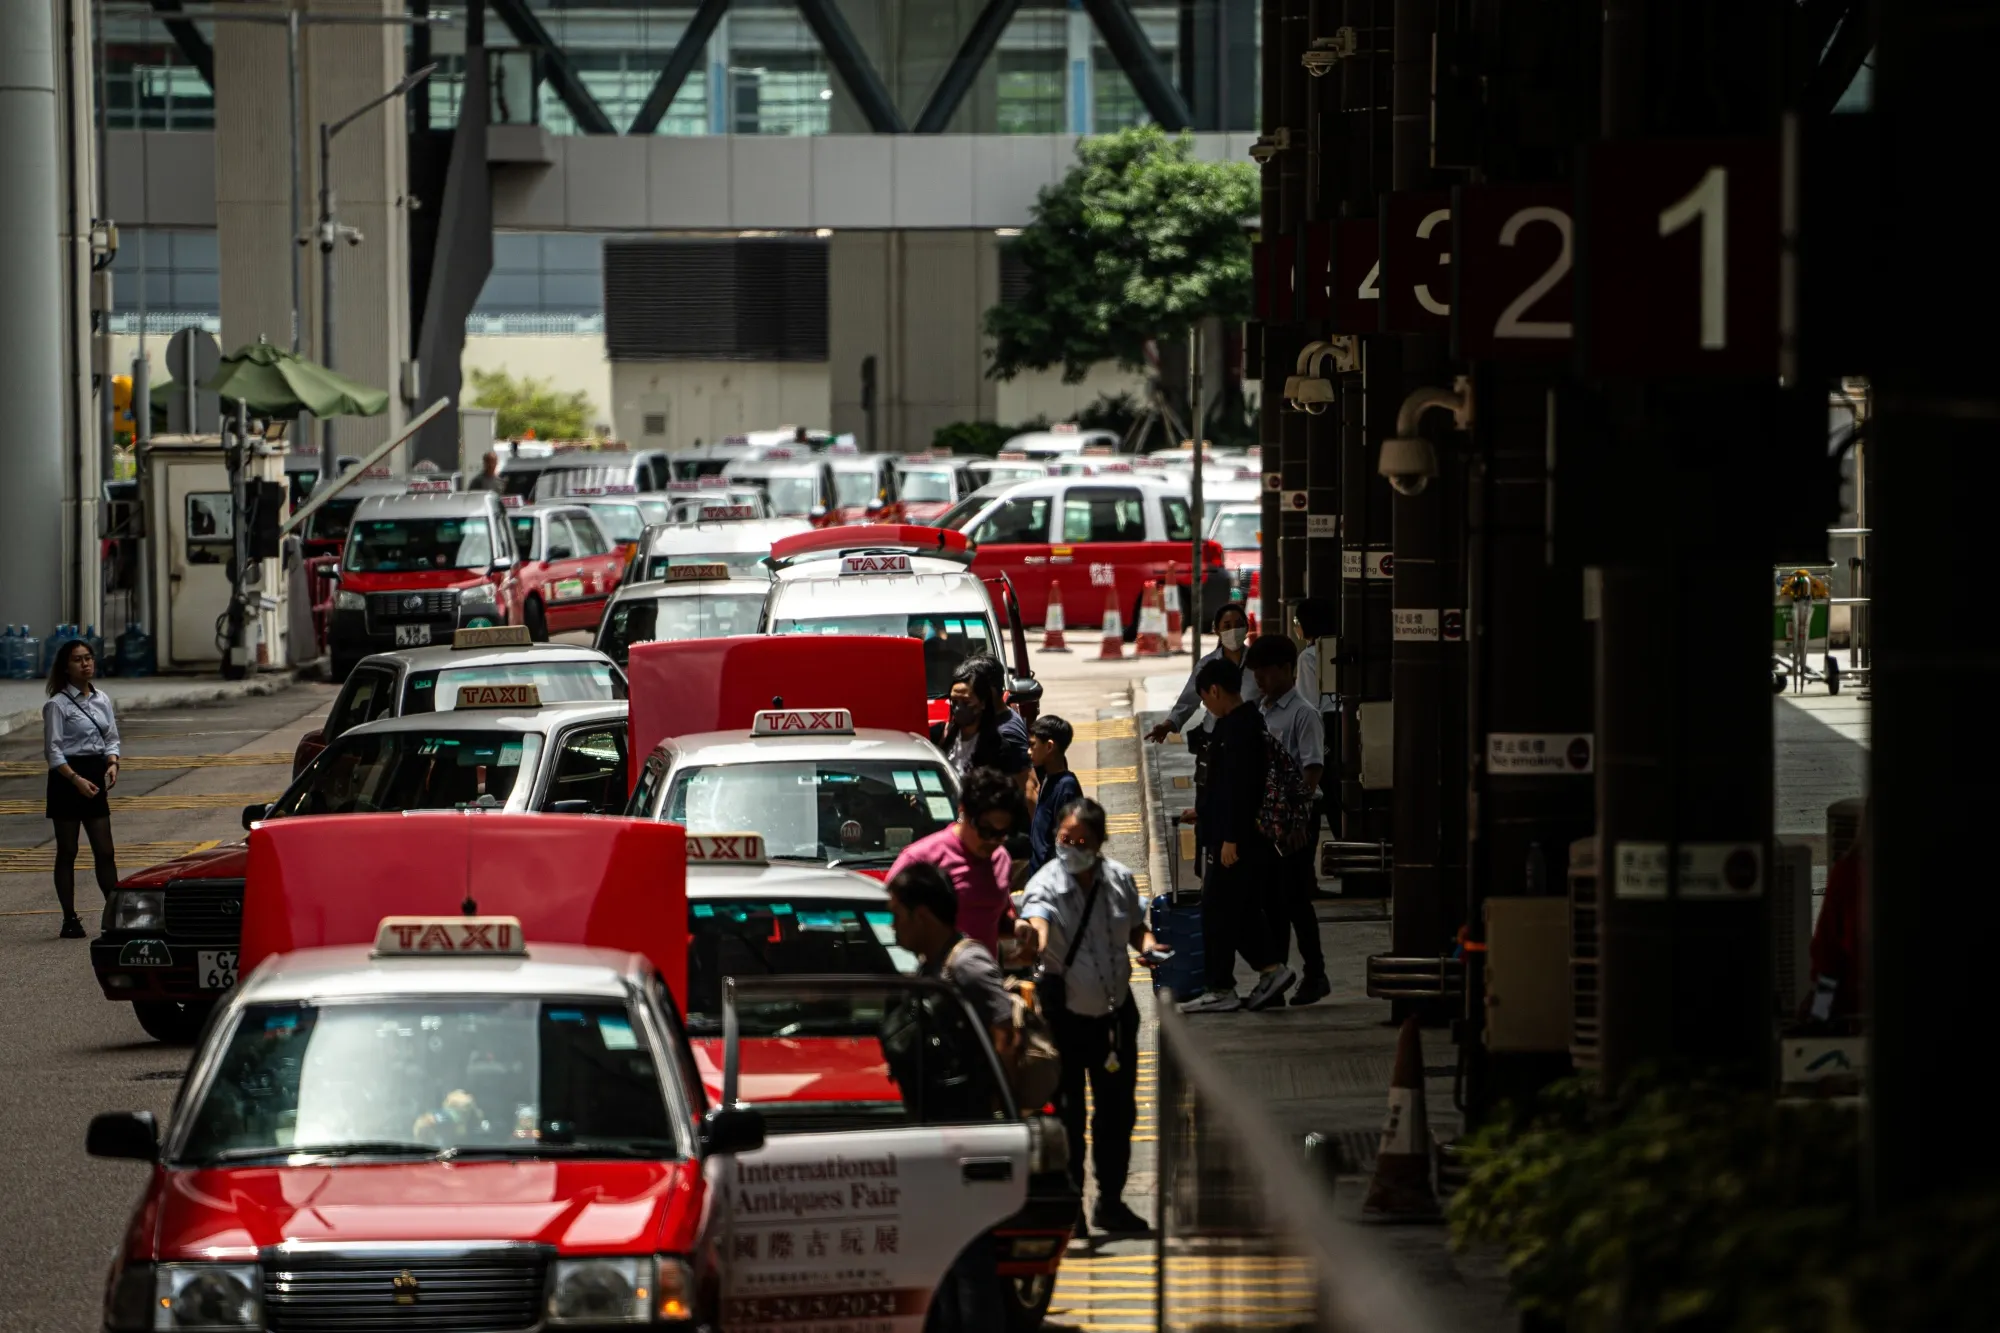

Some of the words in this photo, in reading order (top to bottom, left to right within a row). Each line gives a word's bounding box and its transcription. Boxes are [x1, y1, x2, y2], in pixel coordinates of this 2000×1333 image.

[1657, 164, 1728, 351] 1
[1492, 205, 1575, 339] 2
[703, 506, 751, 518] TAXI
[671, 565, 724, 578] TAXI
[847, 556, 906, 571] TAXI
[460, 628, 525, 645] TAXI
[1402, 625, 1438, 636] smoking
[462, 686, 528, 705] TAXI
[763, 711, 844, 731] TAXI
[1511, 755, 1565, 769] smoking
[686, 835, 758, 860] AXI
[389, 923, 512, 951] TAXI
[139, 944, 150, 957] 4
[129, 957, 161, 965] SEATS
[216, 951, 240, 970] GZ
[207, 970, 235, 988] 66
[736, 1151, 897, 1184] International
[734, 1186, 845, 1216] Antiques
[850, 1180, 901, 1209] Fair
